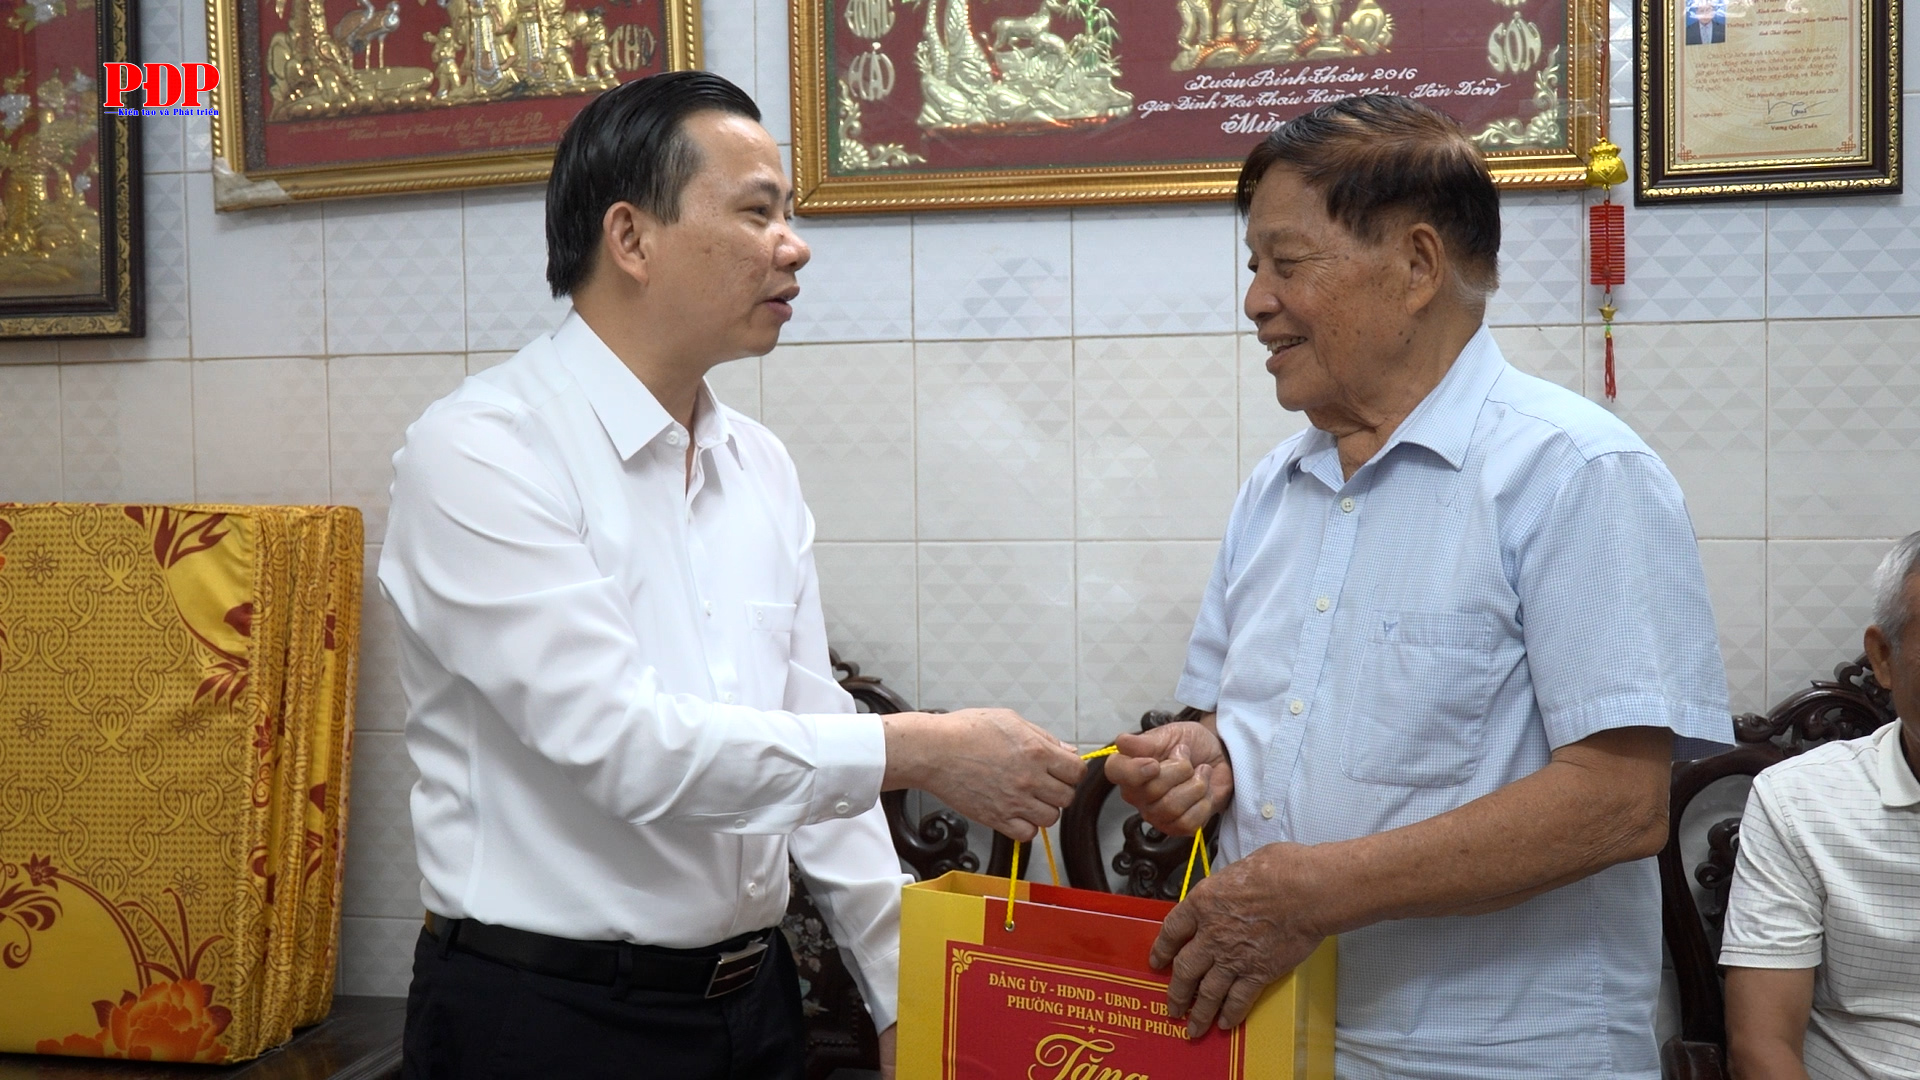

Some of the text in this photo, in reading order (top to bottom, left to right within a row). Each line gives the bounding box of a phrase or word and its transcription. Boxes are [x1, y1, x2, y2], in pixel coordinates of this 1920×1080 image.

[1184, 72, 1248, 91] Xuân
[1371, 67, 1418, 81] 2016
[1137, 99, 1173, 119] Gia
[1173, 91, 1221, 111] Đình
[1219, 112, 1287, 134] Mừn
[989, 971, 1026, 991] ĐẢNG
[1029, 976, 1048, 994] ỦY
[1057, 984, 1096, 1002] HĐND
[1105, 992, 1142, 1011] UBND
[1007, 994, 1191, 1041] PHƯỜNG PHAN ĐÌNH PHÙNG
